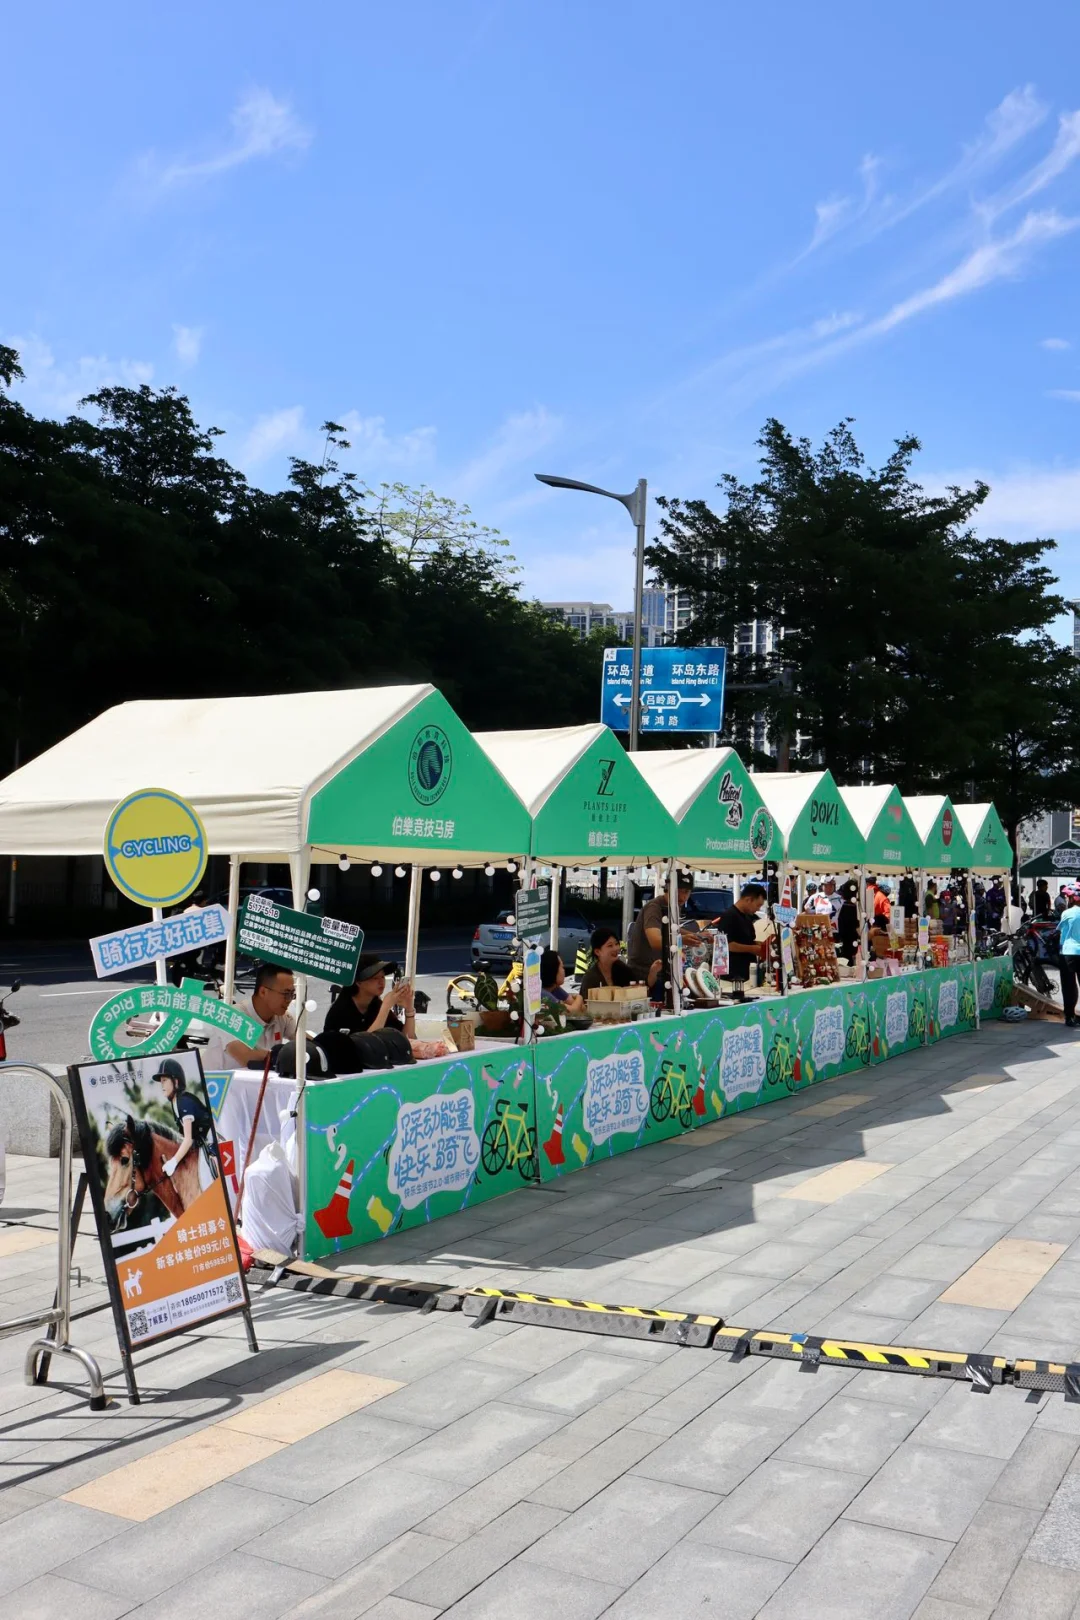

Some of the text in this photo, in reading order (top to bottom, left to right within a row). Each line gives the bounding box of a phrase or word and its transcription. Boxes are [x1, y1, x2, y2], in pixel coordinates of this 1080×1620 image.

[607, 664, 654, 677] 环岛道
[671, 664, 720, 677] 环岛东路
[646, 695, 677, 705] 吕岭路
[583, 801, 627, 812] PLANTS LIFE
[391, 816, 455, 839] 伯樂竞技马房
[122, 836, 191, 858] CYCLING
[322, 918, 359, 937] 能量地图
[100, 909, 225, 971] 骑行友好市集
[104, 996, 135, 1023] Ride
[140, 990, 256, 1041] 踩动能量快乐骑飞
[589, 1057, 642, 1097] 踩动能量
[401, 1096, 473, 1151] 踩动能量
[176, 1217, 226, 1244] 骑士招募令
[155, 1236, 231, 1271] 新客体验价99元/位
[181, 1285, 224, 1308] 18050071572
[148, 1312, 168, 1328] 了解更多
